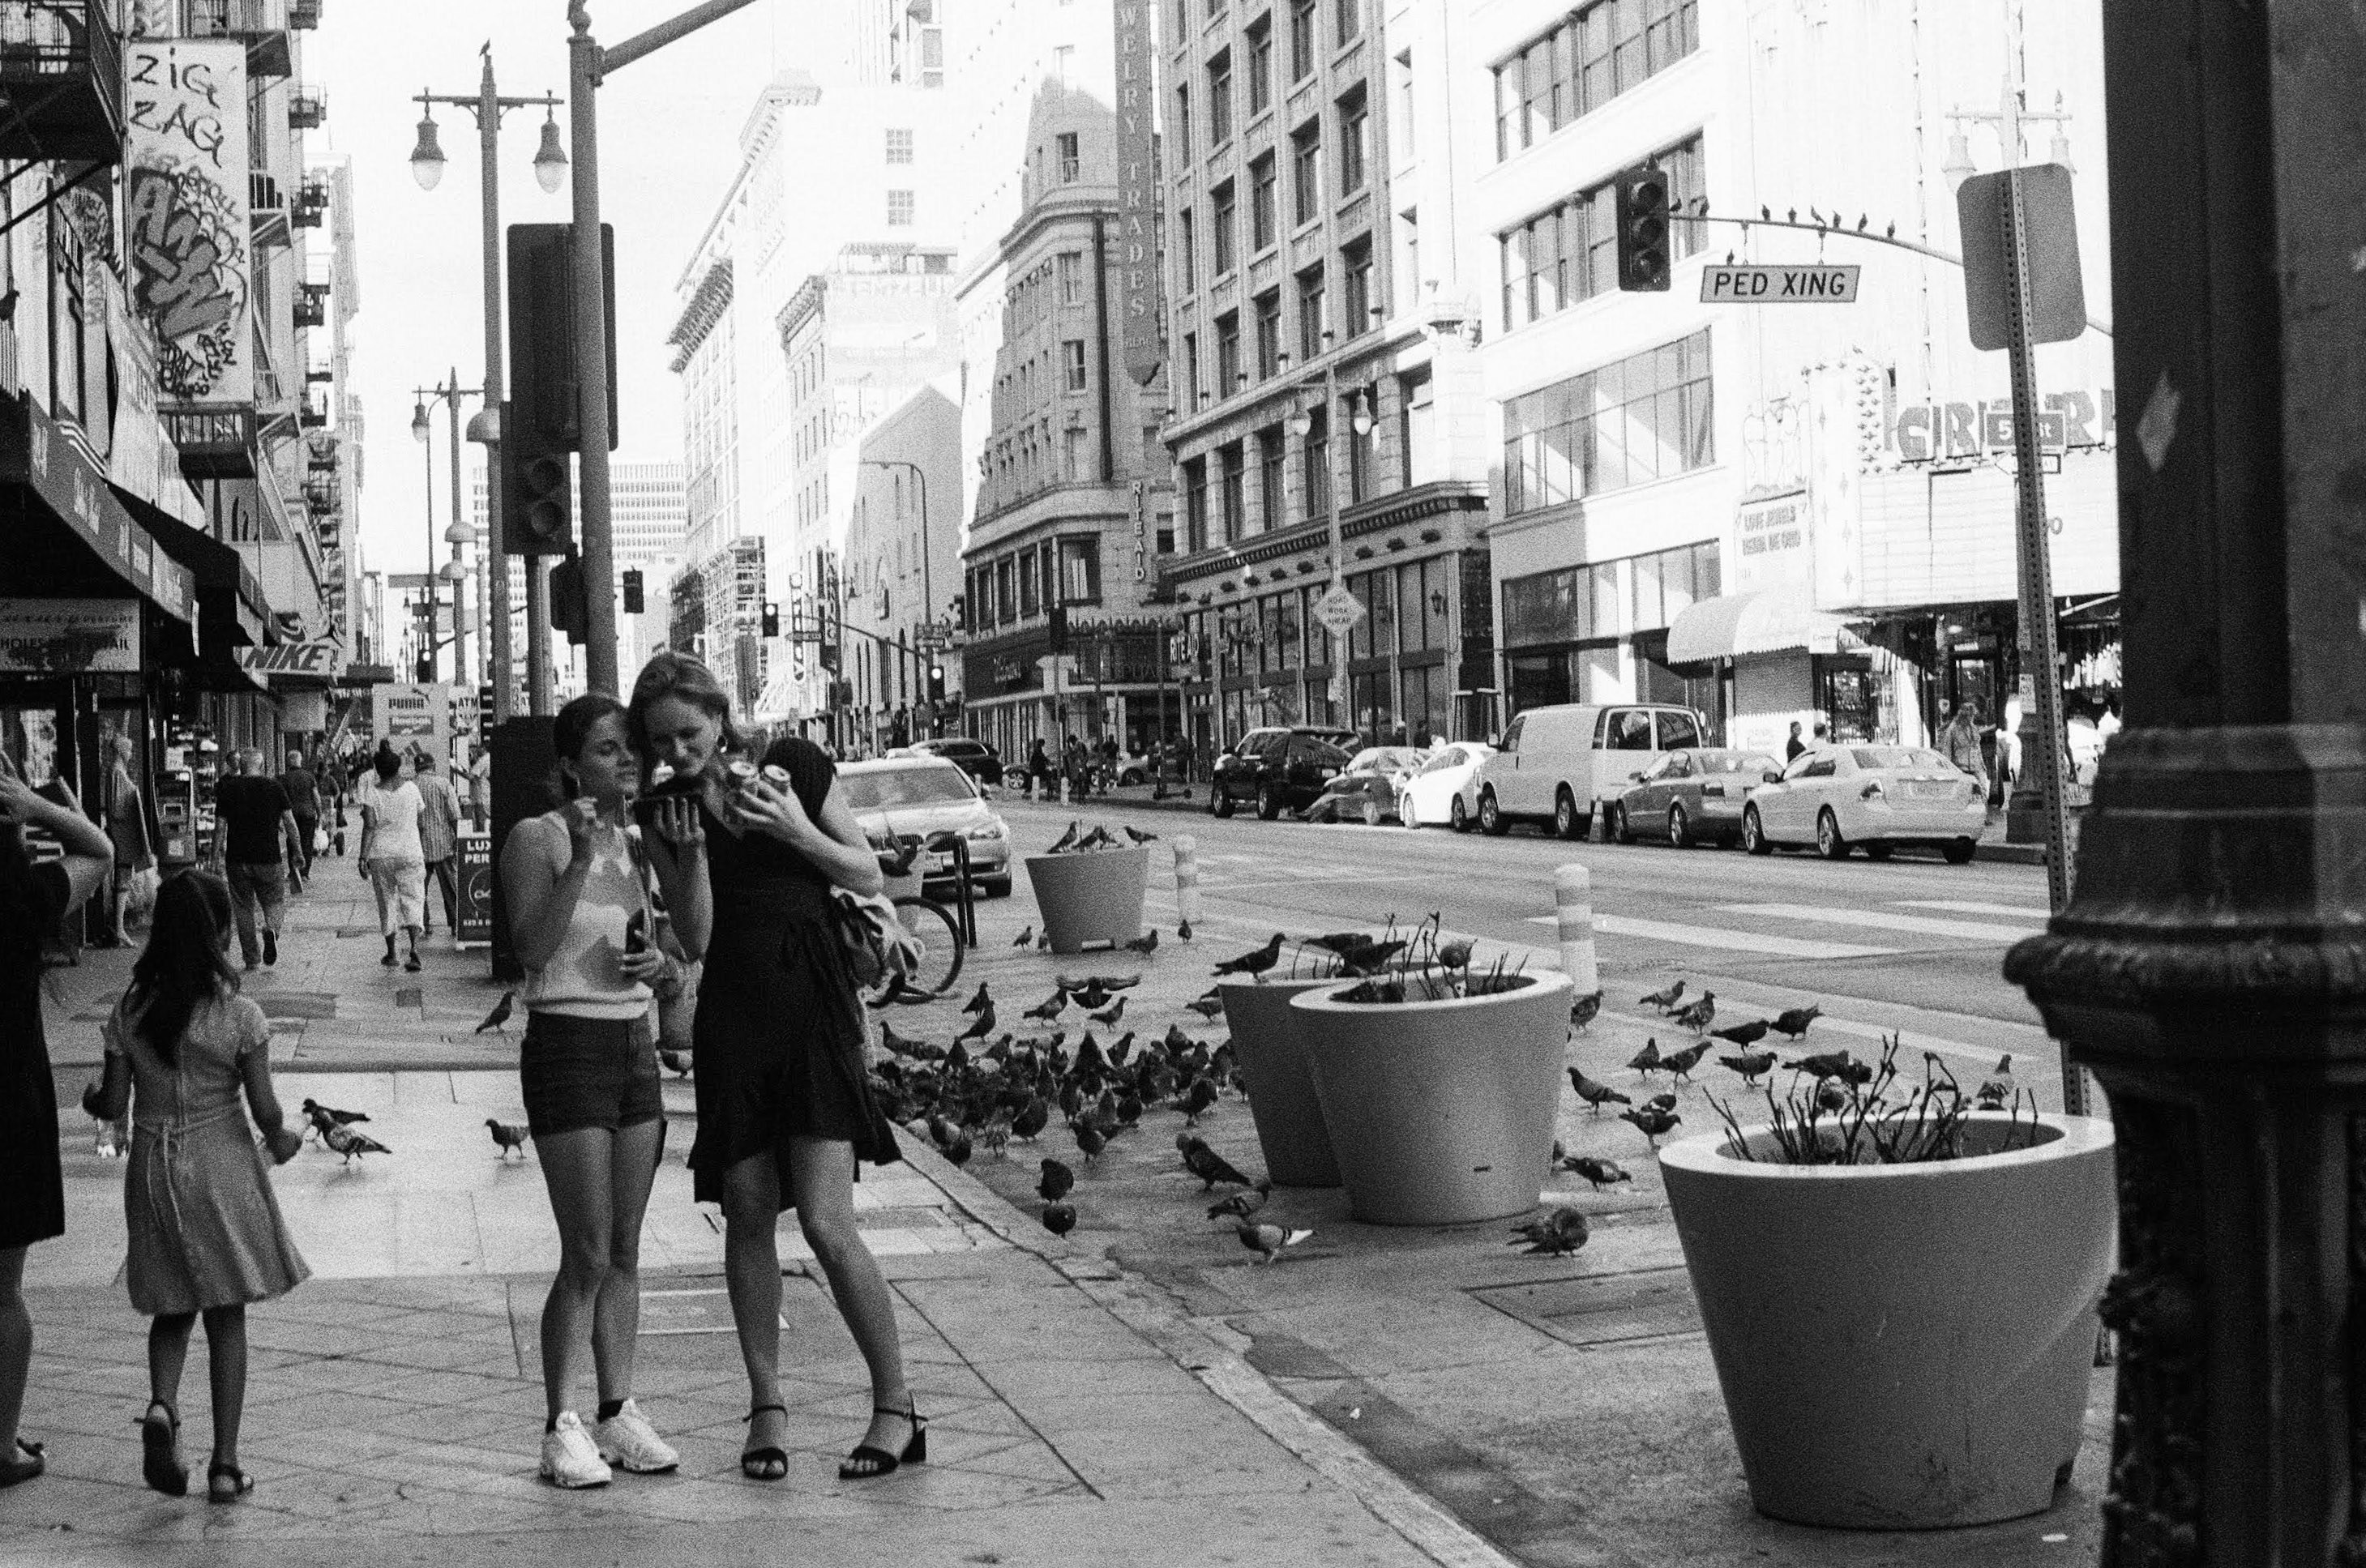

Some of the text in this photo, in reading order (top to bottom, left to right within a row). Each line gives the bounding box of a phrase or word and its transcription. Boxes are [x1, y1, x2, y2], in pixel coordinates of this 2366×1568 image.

[130, 103, 225, 169] ZAG
[1126, 161, 1146, 318] TRADES
[1714, 271, 1846, 297] PED XING
[1132, 481, 1146, 581] RITE AID
[244, 644, 330, 672] NIKE
[458, 697, 479, 707] ATM
